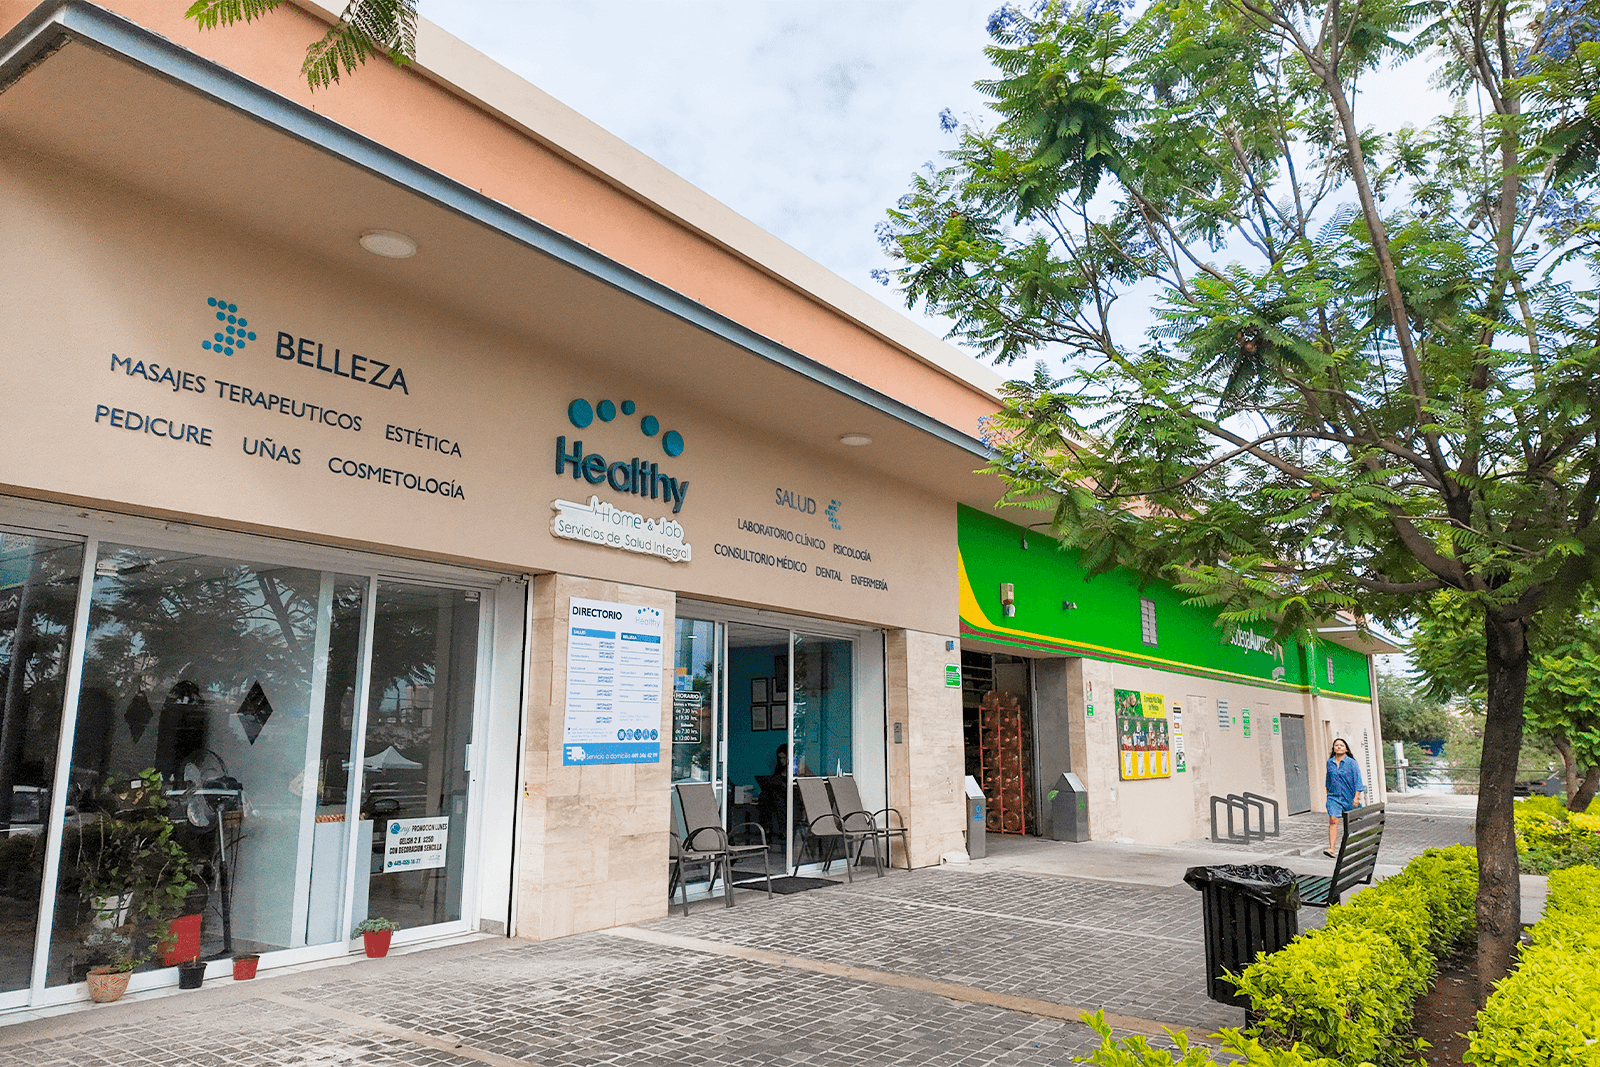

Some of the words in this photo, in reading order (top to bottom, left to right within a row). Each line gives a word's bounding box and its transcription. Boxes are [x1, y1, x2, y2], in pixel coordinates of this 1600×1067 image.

[275, 331, 409, 395] BELLEZA
[110, 353, 206, 393] MASAJES
[215, 380, 363, 432] TERAPEUTICOS
[385, 424, 463, 458] ESTÉTICA
[95, 404, 213, 446] PEDICURE
[242, 436, 301, 465] UÑAS
[328, 457, 465, 500] COSMETOLOGÍA
[555, 436, 690, 513] Healthy
[775, 487, 817, 515] SALUD
[558, 520, 605, 541] Servicios
[607, 532, 621, 544] de
[625, 534, 652, 551] Salud
[654, 541, 689, 560] Integral
[602, 507, 642, 530] Home
[647, 520, 654, 532] &
[659, 520, 682, 539] Job
[737, 518, 794, 542] LABORATORIO
[795, 533, 826, 551] CLÍNICO
[833, 543, 872, 562] PSICOLOGÍA
[713, 543, 775, 567] CONSULTORIO
[776, 555, 807, 573] MÉDICO
[815, 565, 843, 582] DENTAL
[850, 574, 888, 591] ENFERMERÍA
[572, 606, 623, 620] DIRECTORIO
[586, 752, 605, 760] Servicio
[414, 836, 418, 844] 2
